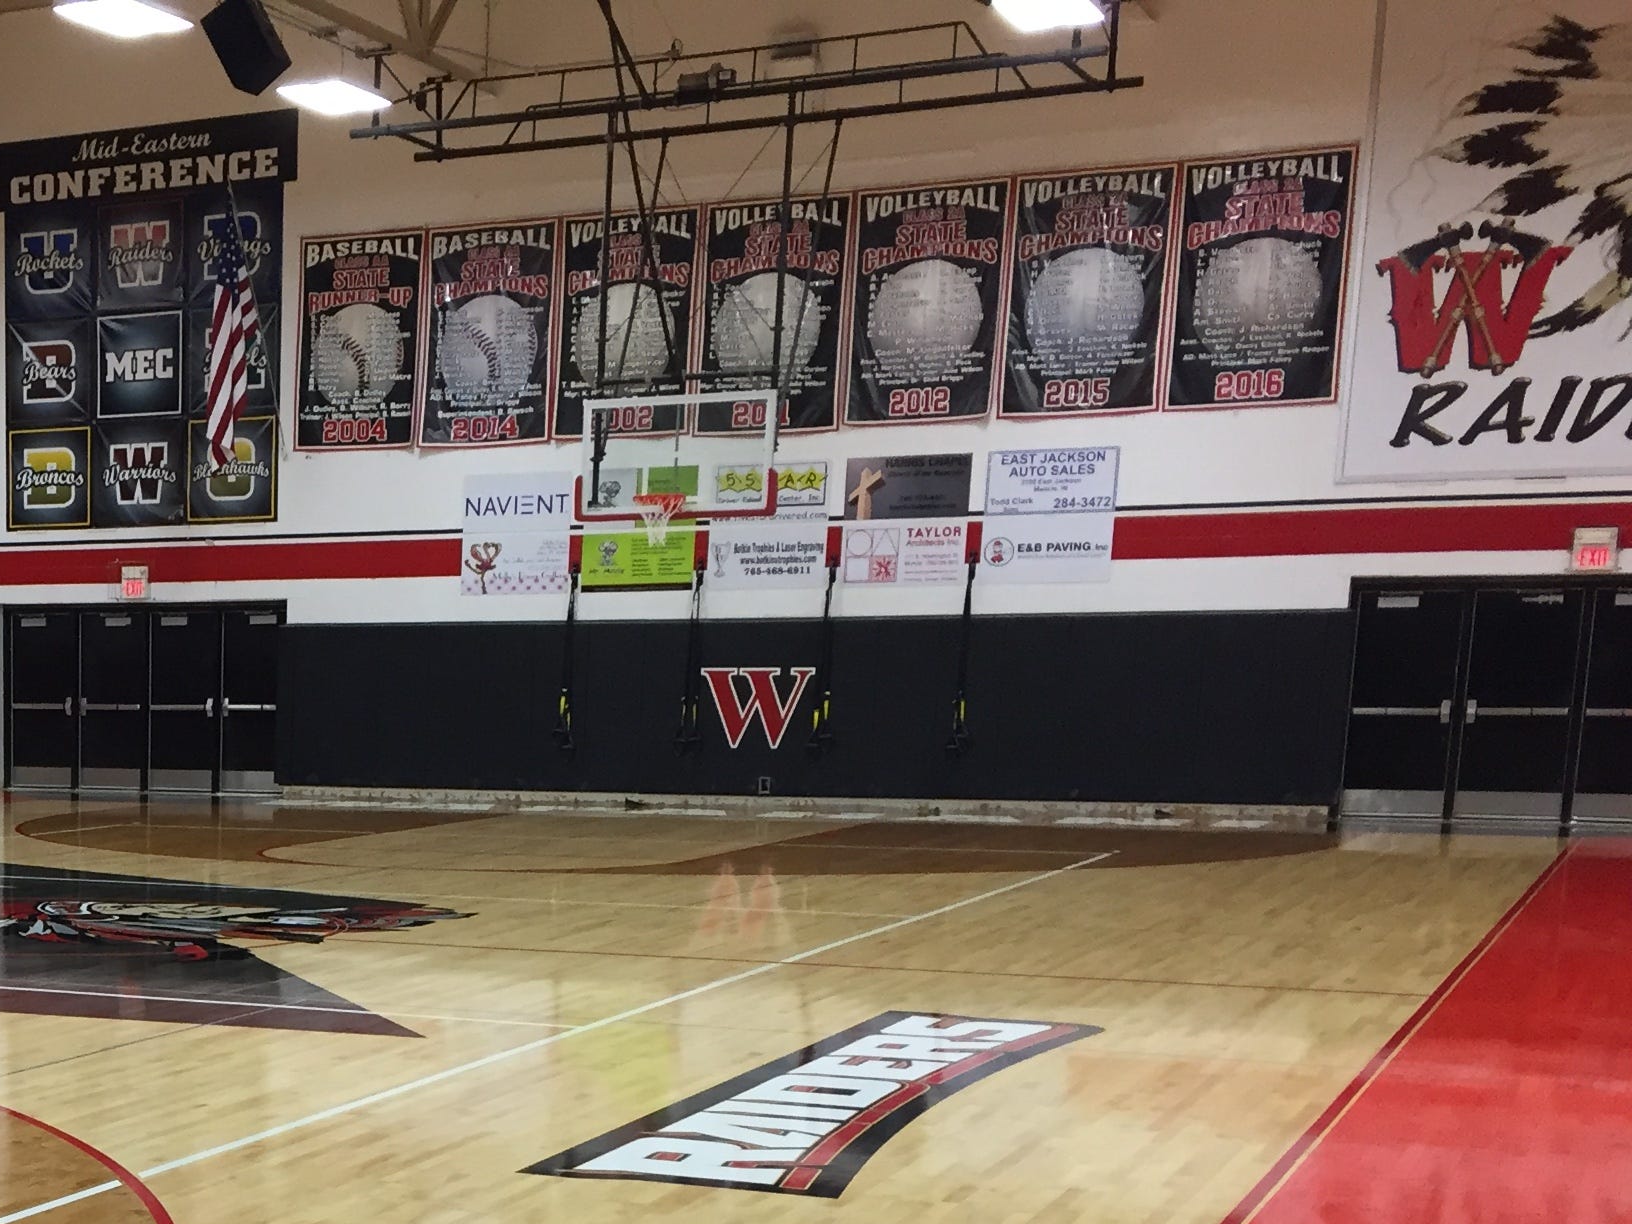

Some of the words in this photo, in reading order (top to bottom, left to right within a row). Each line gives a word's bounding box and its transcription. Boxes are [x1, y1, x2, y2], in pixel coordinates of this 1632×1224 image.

[72, 131, 212, 163] Mid-Eastern
[9, 147, 279, 205] CONFERENCE
[1024, 171, 1166, 208] VOLLEYBALL
[1192, 155, 1344, 196] VOLLEYBALL
[715, 200, 842, 235] VOLLEBALL
[866, 185, 1000, 222] VOLLEYBALL
[1225, 191, 1306, 222] STATE
[570, 213, 691, 248] VOLLEYALL
[895, 220, 968, 245] STATE
[1055, 205, 1129, 235] STATE
[1186, 210, 1342, 250] CHAMPIONS
[108, 240, 174, 270] Raiders
[306, 237, 419, 268] BASEBALL
[432, 227, 552, 260] BASEBALL
[862, 237, 999, 275] CHAMPIONS
[1019, 224, 1164, 261] CHAMPIONS
[14, 251, 84, 277] Rockets
[333, 267, 390, 290] STATE
[461, 257, 521, 281] STATE
[308, 286, 414, 317] RUNNER-UP
[434, 274, 549, 307] CHAMPIONS
[23, 361, 77, 385] Bears
[105, 348, 174, 383] MEC
[1043, 377, 1111, 408] 2015
[1214, 368, 1285, 401] 2016
[889, 386, 951, 417] 2012
[1389, 374, 1632, 448] RAID
[322, 417, 388, 443] 2004
[451, 414, 519, 441] 2014
[193, 460, 270, 483] Blhawks
[1001, 453, 1037, 466] EAST
[1040, 450, 1107, 464] JACKSON
[1009, 465, 1047, 478] AUTO
[1050, 463, 1096, 476] SALES
[15, 466, 85, 491] Broncos
[102, 463, 177, 488] Warriors
[465, 493, 570, 517] NAVIENT
[1012, 497, 1033, 505] Clark
[1053, 496, 1112, 509] 284-3472
[907, 526, 962, 538] TAYLOR
[1017, 543, 1043, 553] E&B
[1046, 541, 1091, 552] PAVING
[797, 541, 824, 555] Engraving
[1577, 546, 1611, 567] EXIT
[122, 578, 146, 599] EXIT
[700, 667, 816, 750] W
[572, 1013, 1058, 1187] RAIDERS
